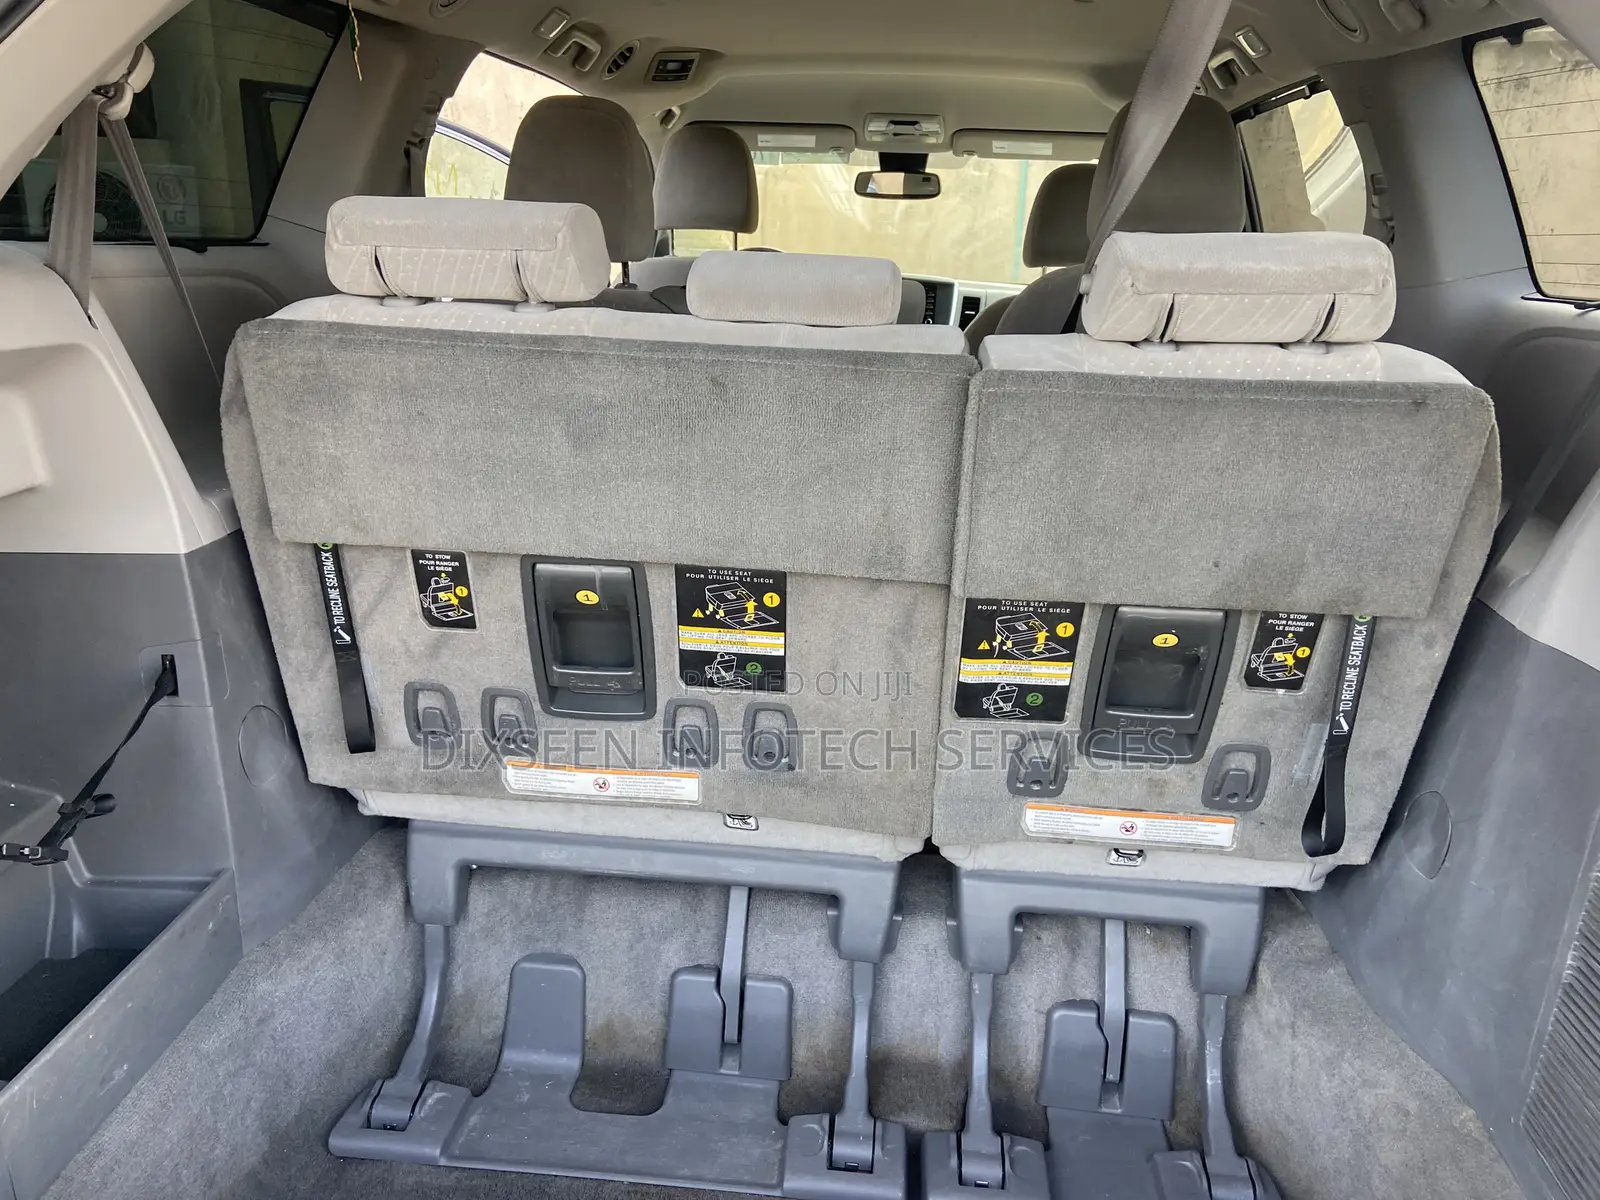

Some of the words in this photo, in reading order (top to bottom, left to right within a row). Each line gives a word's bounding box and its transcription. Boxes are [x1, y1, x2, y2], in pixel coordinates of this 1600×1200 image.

[163, 210, 186, 225] LG
[321, 551, 339, 587] SEATBACK
[328, 588, 345, 616] RECLINE
[335, 616, 346, 625] TO
[1348, 624, 1367, 666] SEATBACK
[750, 663, 758, 674] 2
[1342, 667, 1360, 701] RECLINE
[1030, 694, 1039, 704] 2
[1340, 702, 1352, 711] TO
